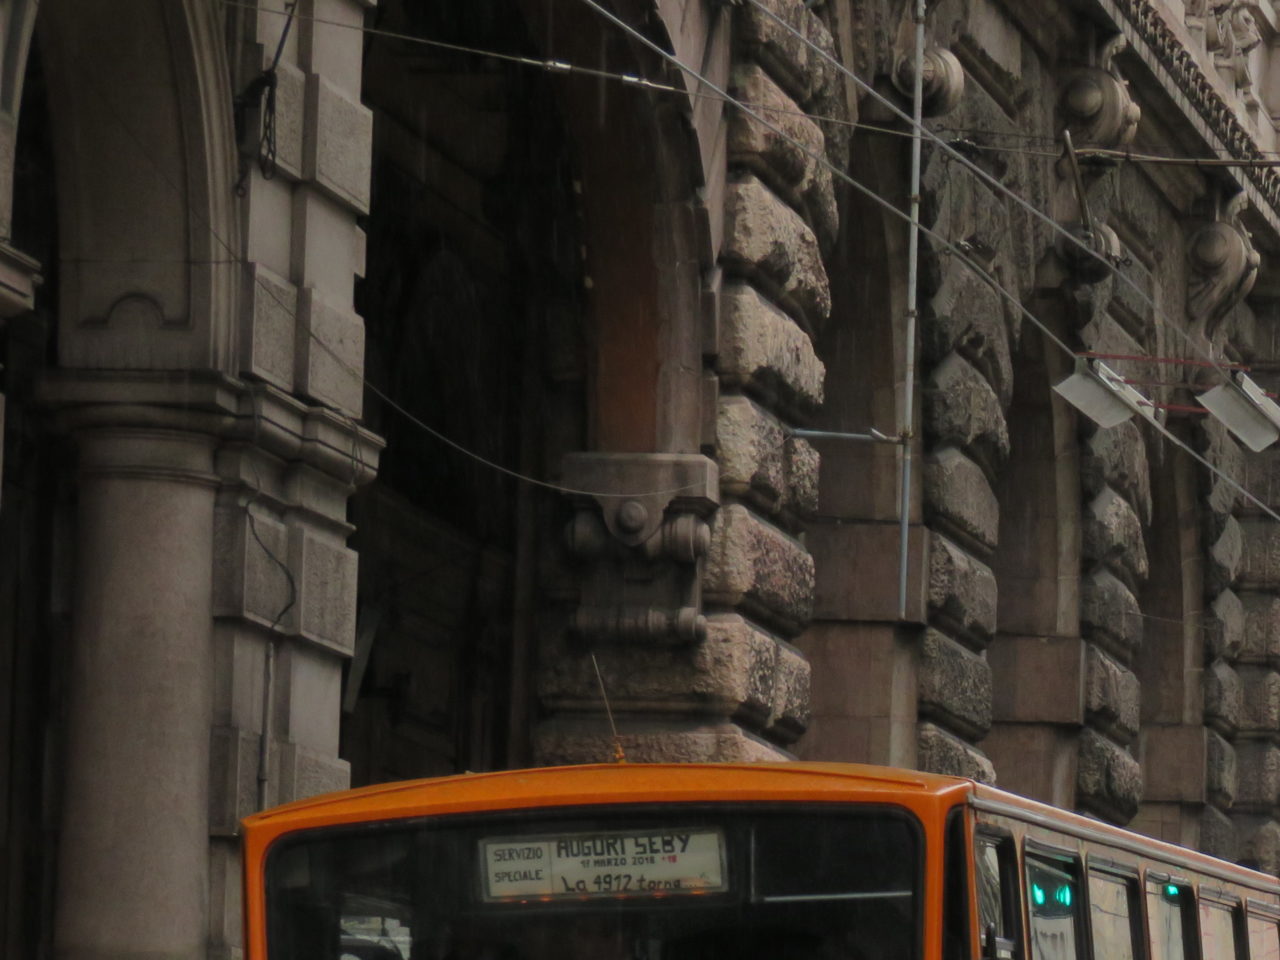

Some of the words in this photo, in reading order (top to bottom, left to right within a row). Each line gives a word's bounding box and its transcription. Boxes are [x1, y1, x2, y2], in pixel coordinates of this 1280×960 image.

[635, 834, 690, 855] SEBY
[493, 847, 544, 863] SERVIZIO
[593, 857, 627, 867] MARZO
[494, 870, 544, 884] SPECIALE
[593, 873, 634, 891] 4912
